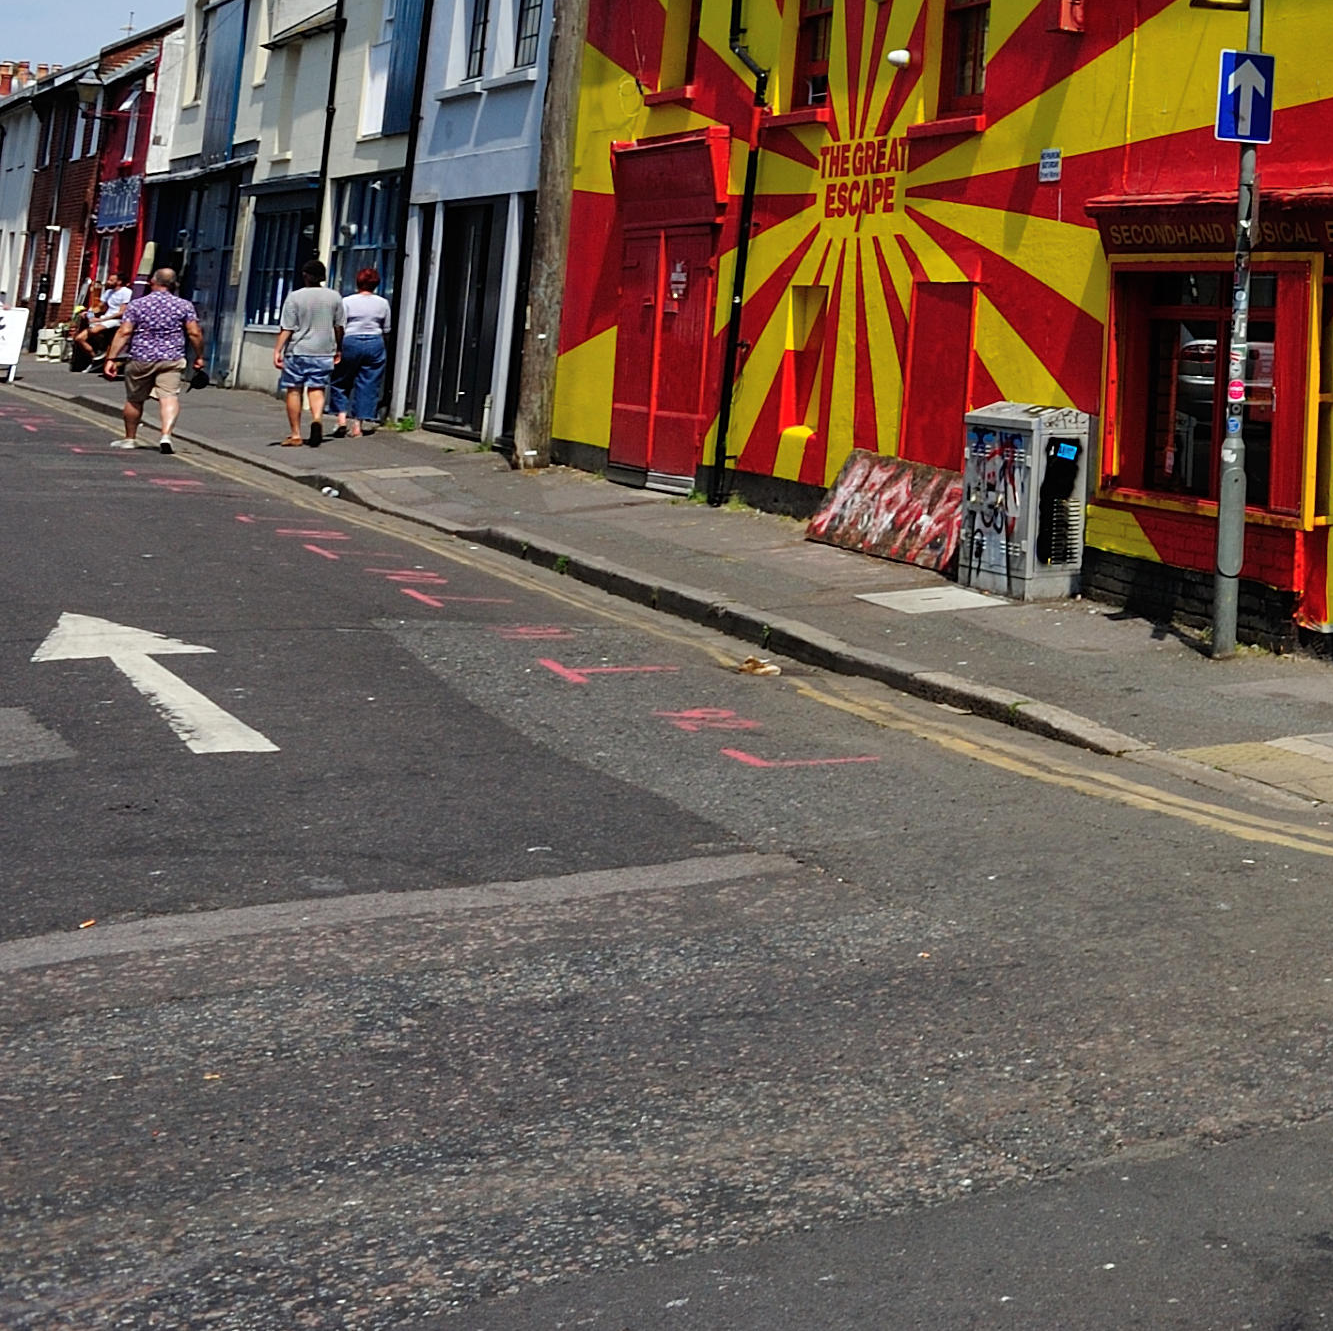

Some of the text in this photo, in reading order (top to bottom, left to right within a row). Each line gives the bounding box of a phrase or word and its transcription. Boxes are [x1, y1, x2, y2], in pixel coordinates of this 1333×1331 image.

[820, 137, 909, 179] THE GREAT
[824, 177, 896, 232] ESCAPE
[1110, 222, 1225, 246] SECONDHAND
